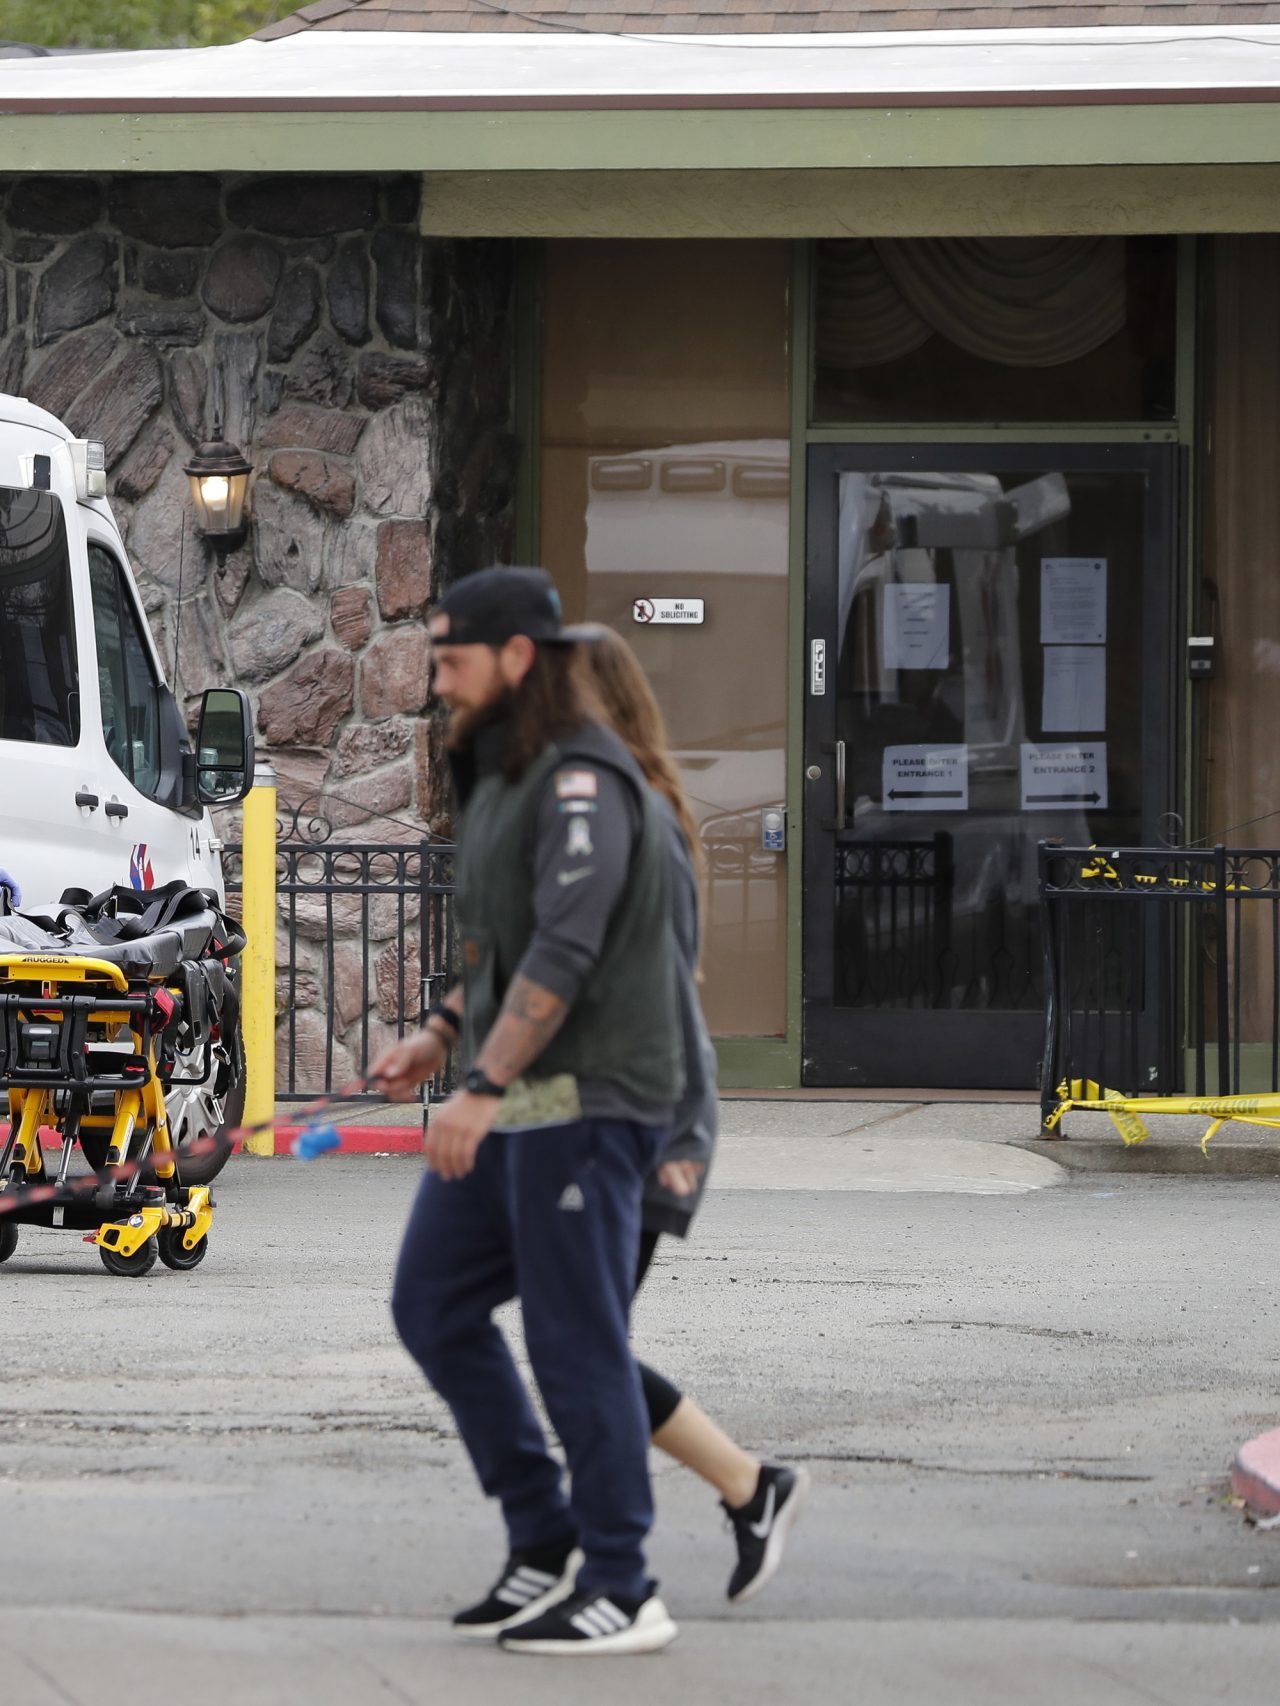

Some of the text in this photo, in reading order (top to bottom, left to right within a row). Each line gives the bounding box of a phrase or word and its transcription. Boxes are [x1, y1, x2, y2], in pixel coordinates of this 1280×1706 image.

[675, 602, 685, 610] NO
[660, 610, 699, 619] SOLICITING
[815, 644, 824, 682] PULL
[1028, 751, 1095, 760] PLEASE ENTER
[892, 758, 926, 766] PLEASE
[1033, 765, 1096, 774] ENTRANCE 2
[27, 956, 64, 964] RUGGED
